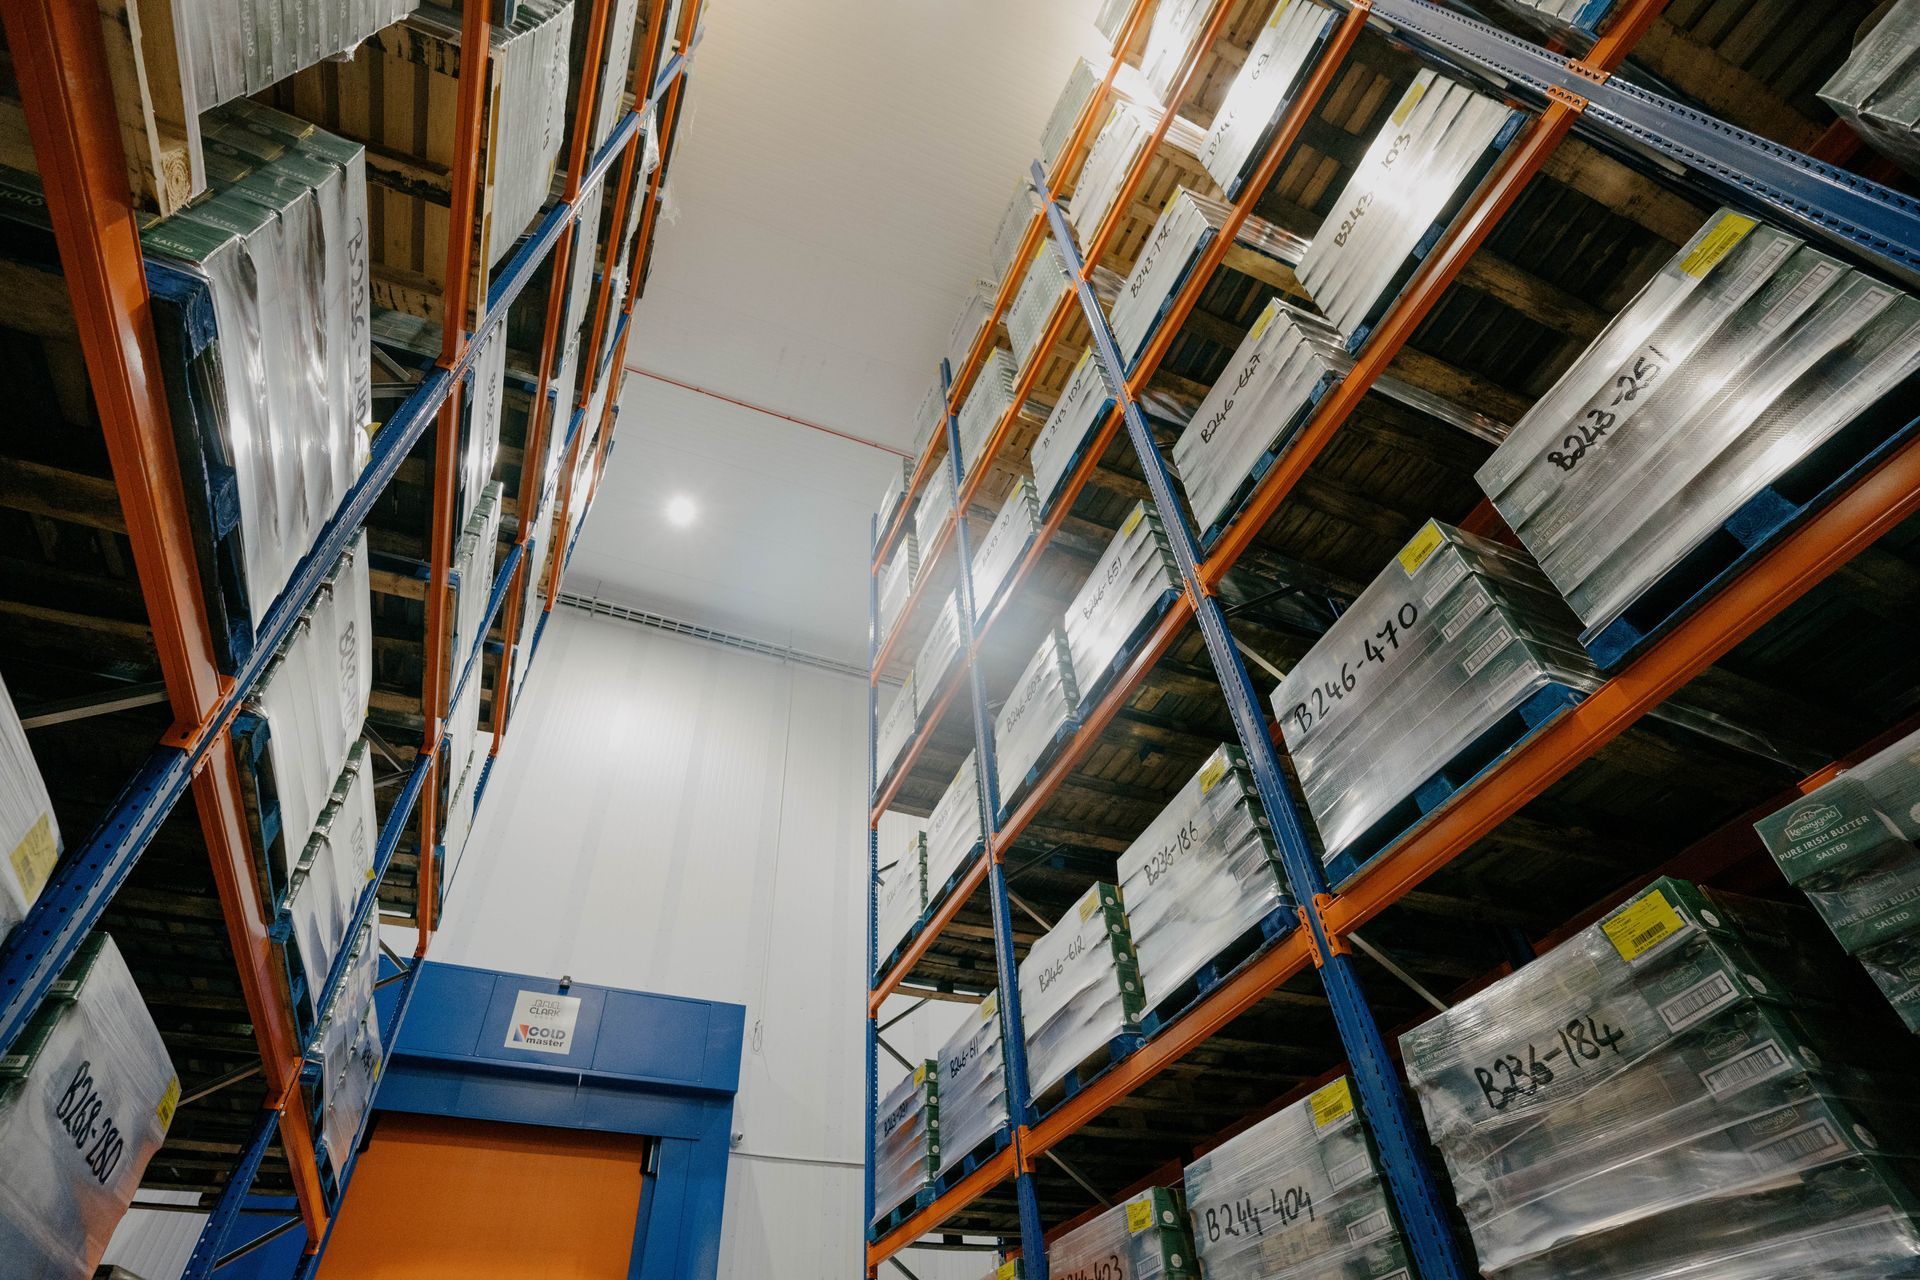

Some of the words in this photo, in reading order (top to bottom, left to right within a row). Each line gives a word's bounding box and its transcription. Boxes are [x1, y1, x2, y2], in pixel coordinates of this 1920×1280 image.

[202, 213, 239, 230] SALTED
[152, 237, 194, 254] SALTED
[1200, 353, 1261, 444] B246-647
[1547, 345, 1670, 471] B243-251
[1294, 602, 1418, 734] B246-470
[1779, 844, 1802, 861] PURE
[1803, 834, 1829, 850] IRISH
[1831, 815, 1870, 837] BUTTER
[1790, 810, 1838, 838] Kerrygold
[1144, 821, 1199, 886] B236-186
[1816, 843, 1848, 861] SALTED
[1833, 913, 1859, 930] PURE
[1860, 901, 1888, 918] IRISH
[1874, 912, 1910, 930] SALTED
[1039, 935, 1085, 993] B246-612
[529, 1007, 560, 1016] CLARK
[526, 1038, 564, 1047] master
[1474, 1015, 1625, 1110] B236-184
[56, 1061, 123, 1185] B268-280
[1205, 1186, 1315, 1243] B244-404
